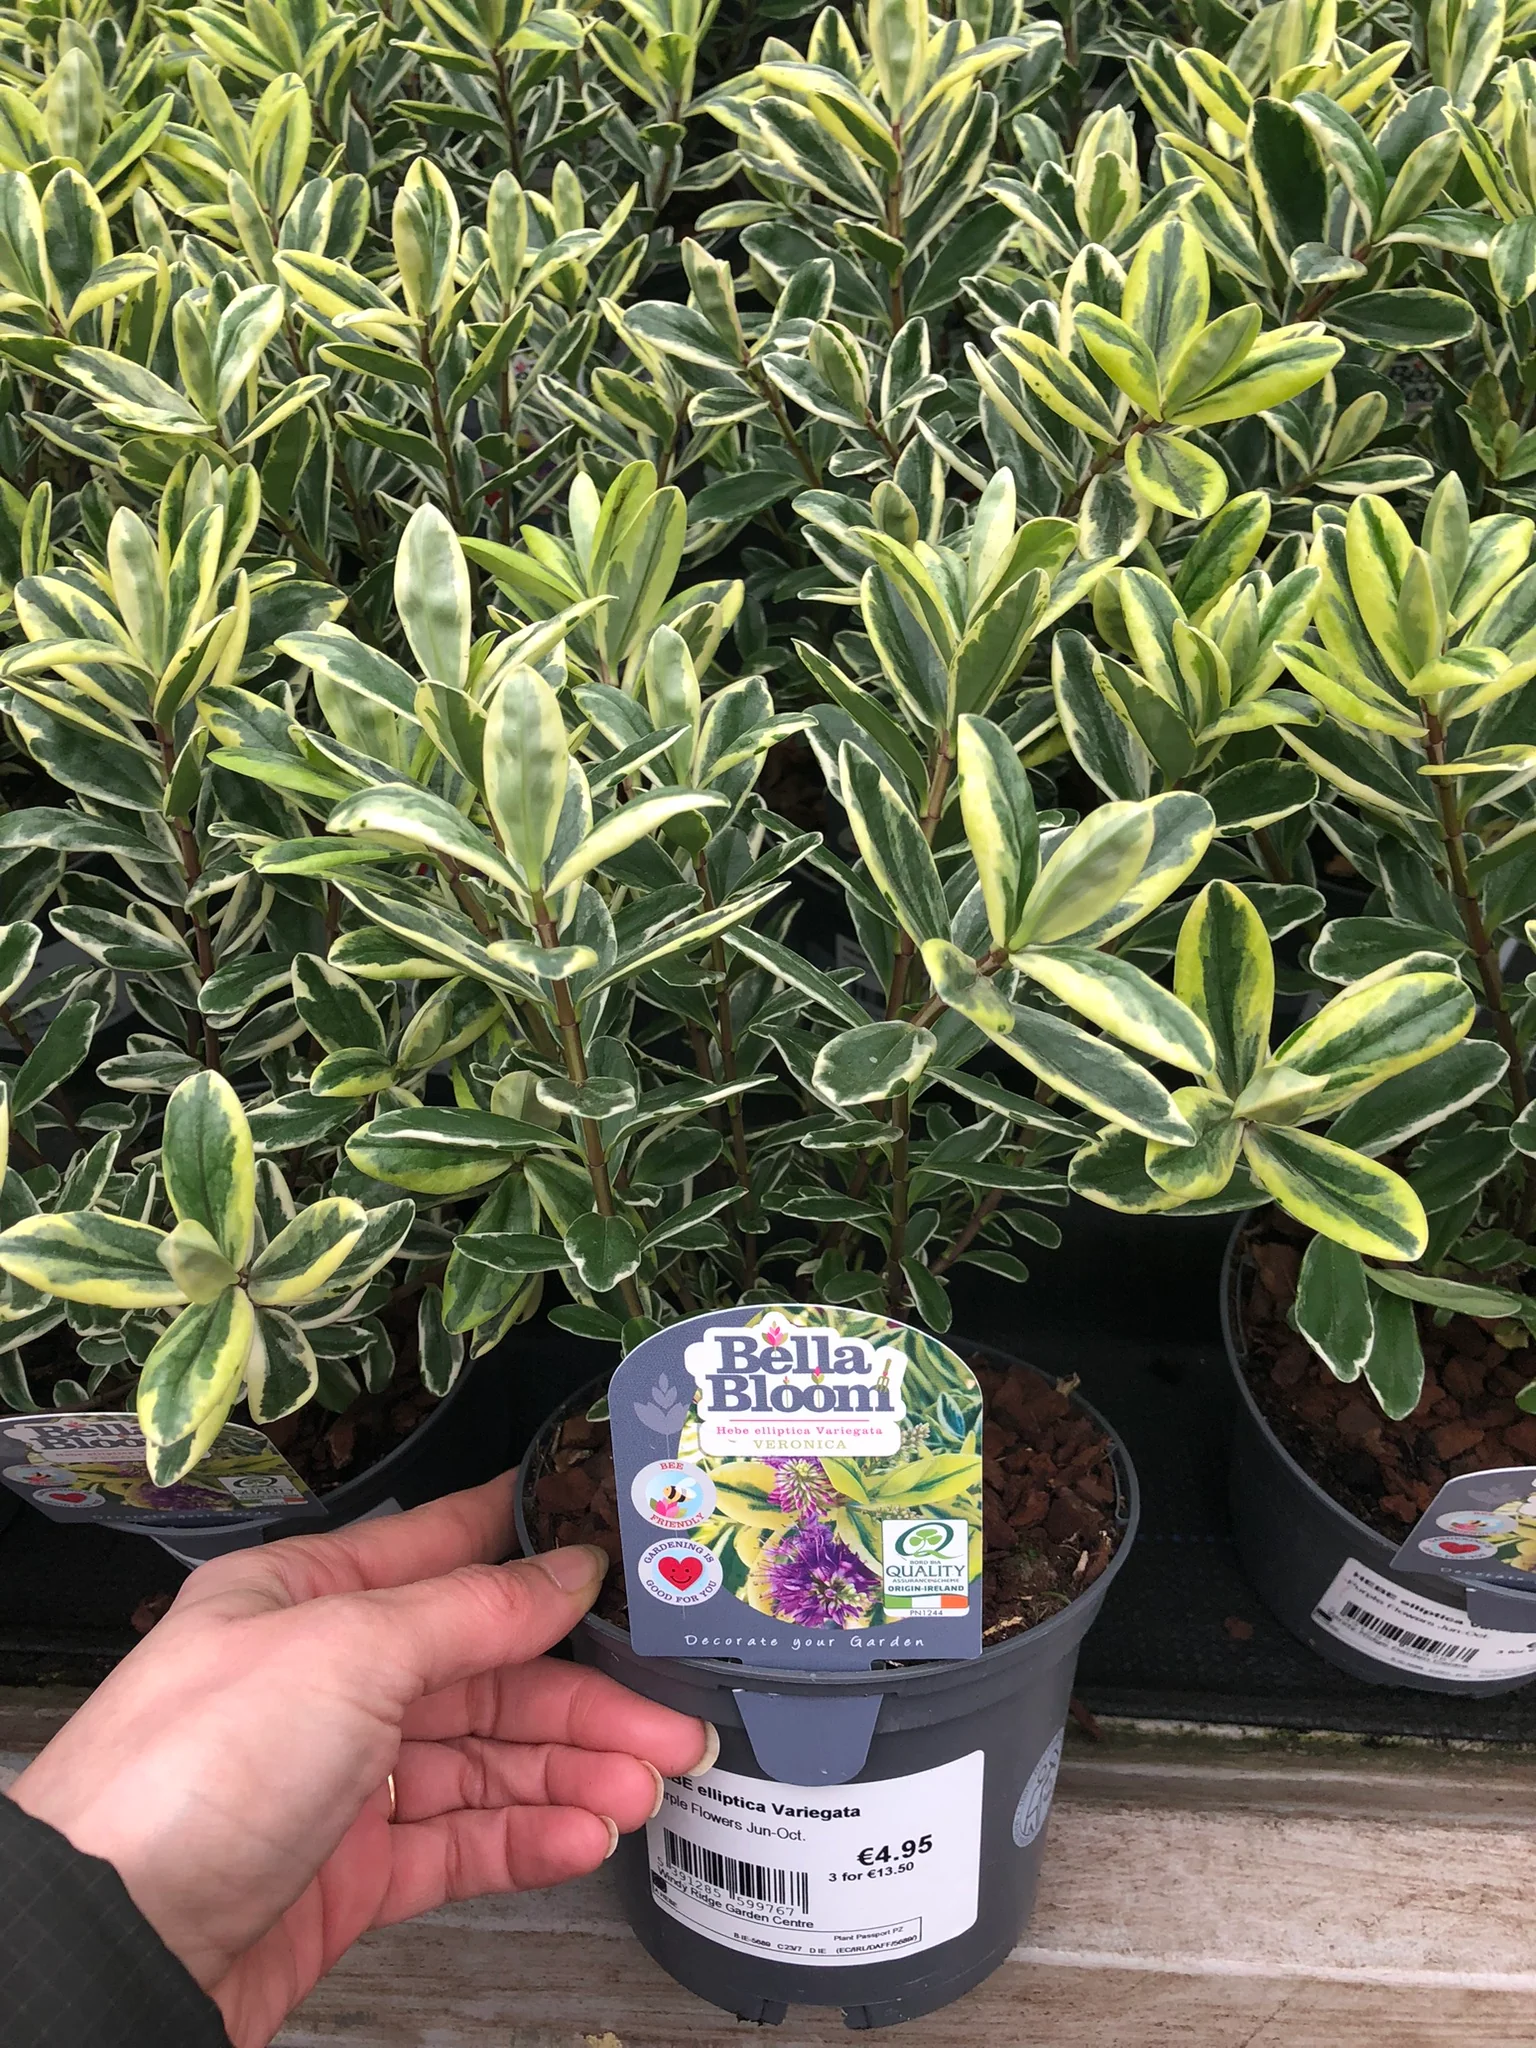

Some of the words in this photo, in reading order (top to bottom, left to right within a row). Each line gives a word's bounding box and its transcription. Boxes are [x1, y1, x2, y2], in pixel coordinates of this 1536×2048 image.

[714, 1336, 872, 1374] Bella
[705, 1374, 895, 1413] Bloom
[716, 1426, 749, 1435] Hebe
[754, 1425, 811, 1437] elliptica
[816, 1425, 883, 1437] Variegata
[29, 1437, 147, 1450] Bloo
[753, 1439, 847, 1450] VERONICA
[659, 1461, 684, 1471] BEE
[650, 1512, 705, 1529] FRIENDLY
[643, 1540, 704, 1564] GARDENING
[703, 1552, 715, 1564] IS
[885, 1564, 966, 1578] QUALITY
[645, 1579, 673, 1602] GOOD
[675, 1594, 699, 1604] FOR
[699, 1580, 717, 1598] YOU
[684, 1634, 779, 1647] Decorate
[791, 1637, 836, 1650] your
[850, 1635, 925, 1647] Garden
[698, 1785, 766, 1813] elliptica
[771, 1802, 861, 1821] Variegata
[663, 1790, 689, 1811] rple
[691, 1802, 743, 1831] Flowers
[746, 1821, 806, 1841] Jun-Oct.
[857, 1833, 933, 1867] €4.95
[828, 1872, 838, 1882] 3
[842, 1871, 863, 1882] for
[867, 1861, 914, 1879] €13.50
[657, 1865, 688, 1893] Windy
[690, 1887, 723, 1909] Ridge
[725, 1903, 769, 1923] Garden
[772, 1915, 814, 1929] Centre
[670, 1866, 722, 1898] 391285
[736, 1895, 795, 1917] 599767
[856, 1929, 891, 1940] Passport
